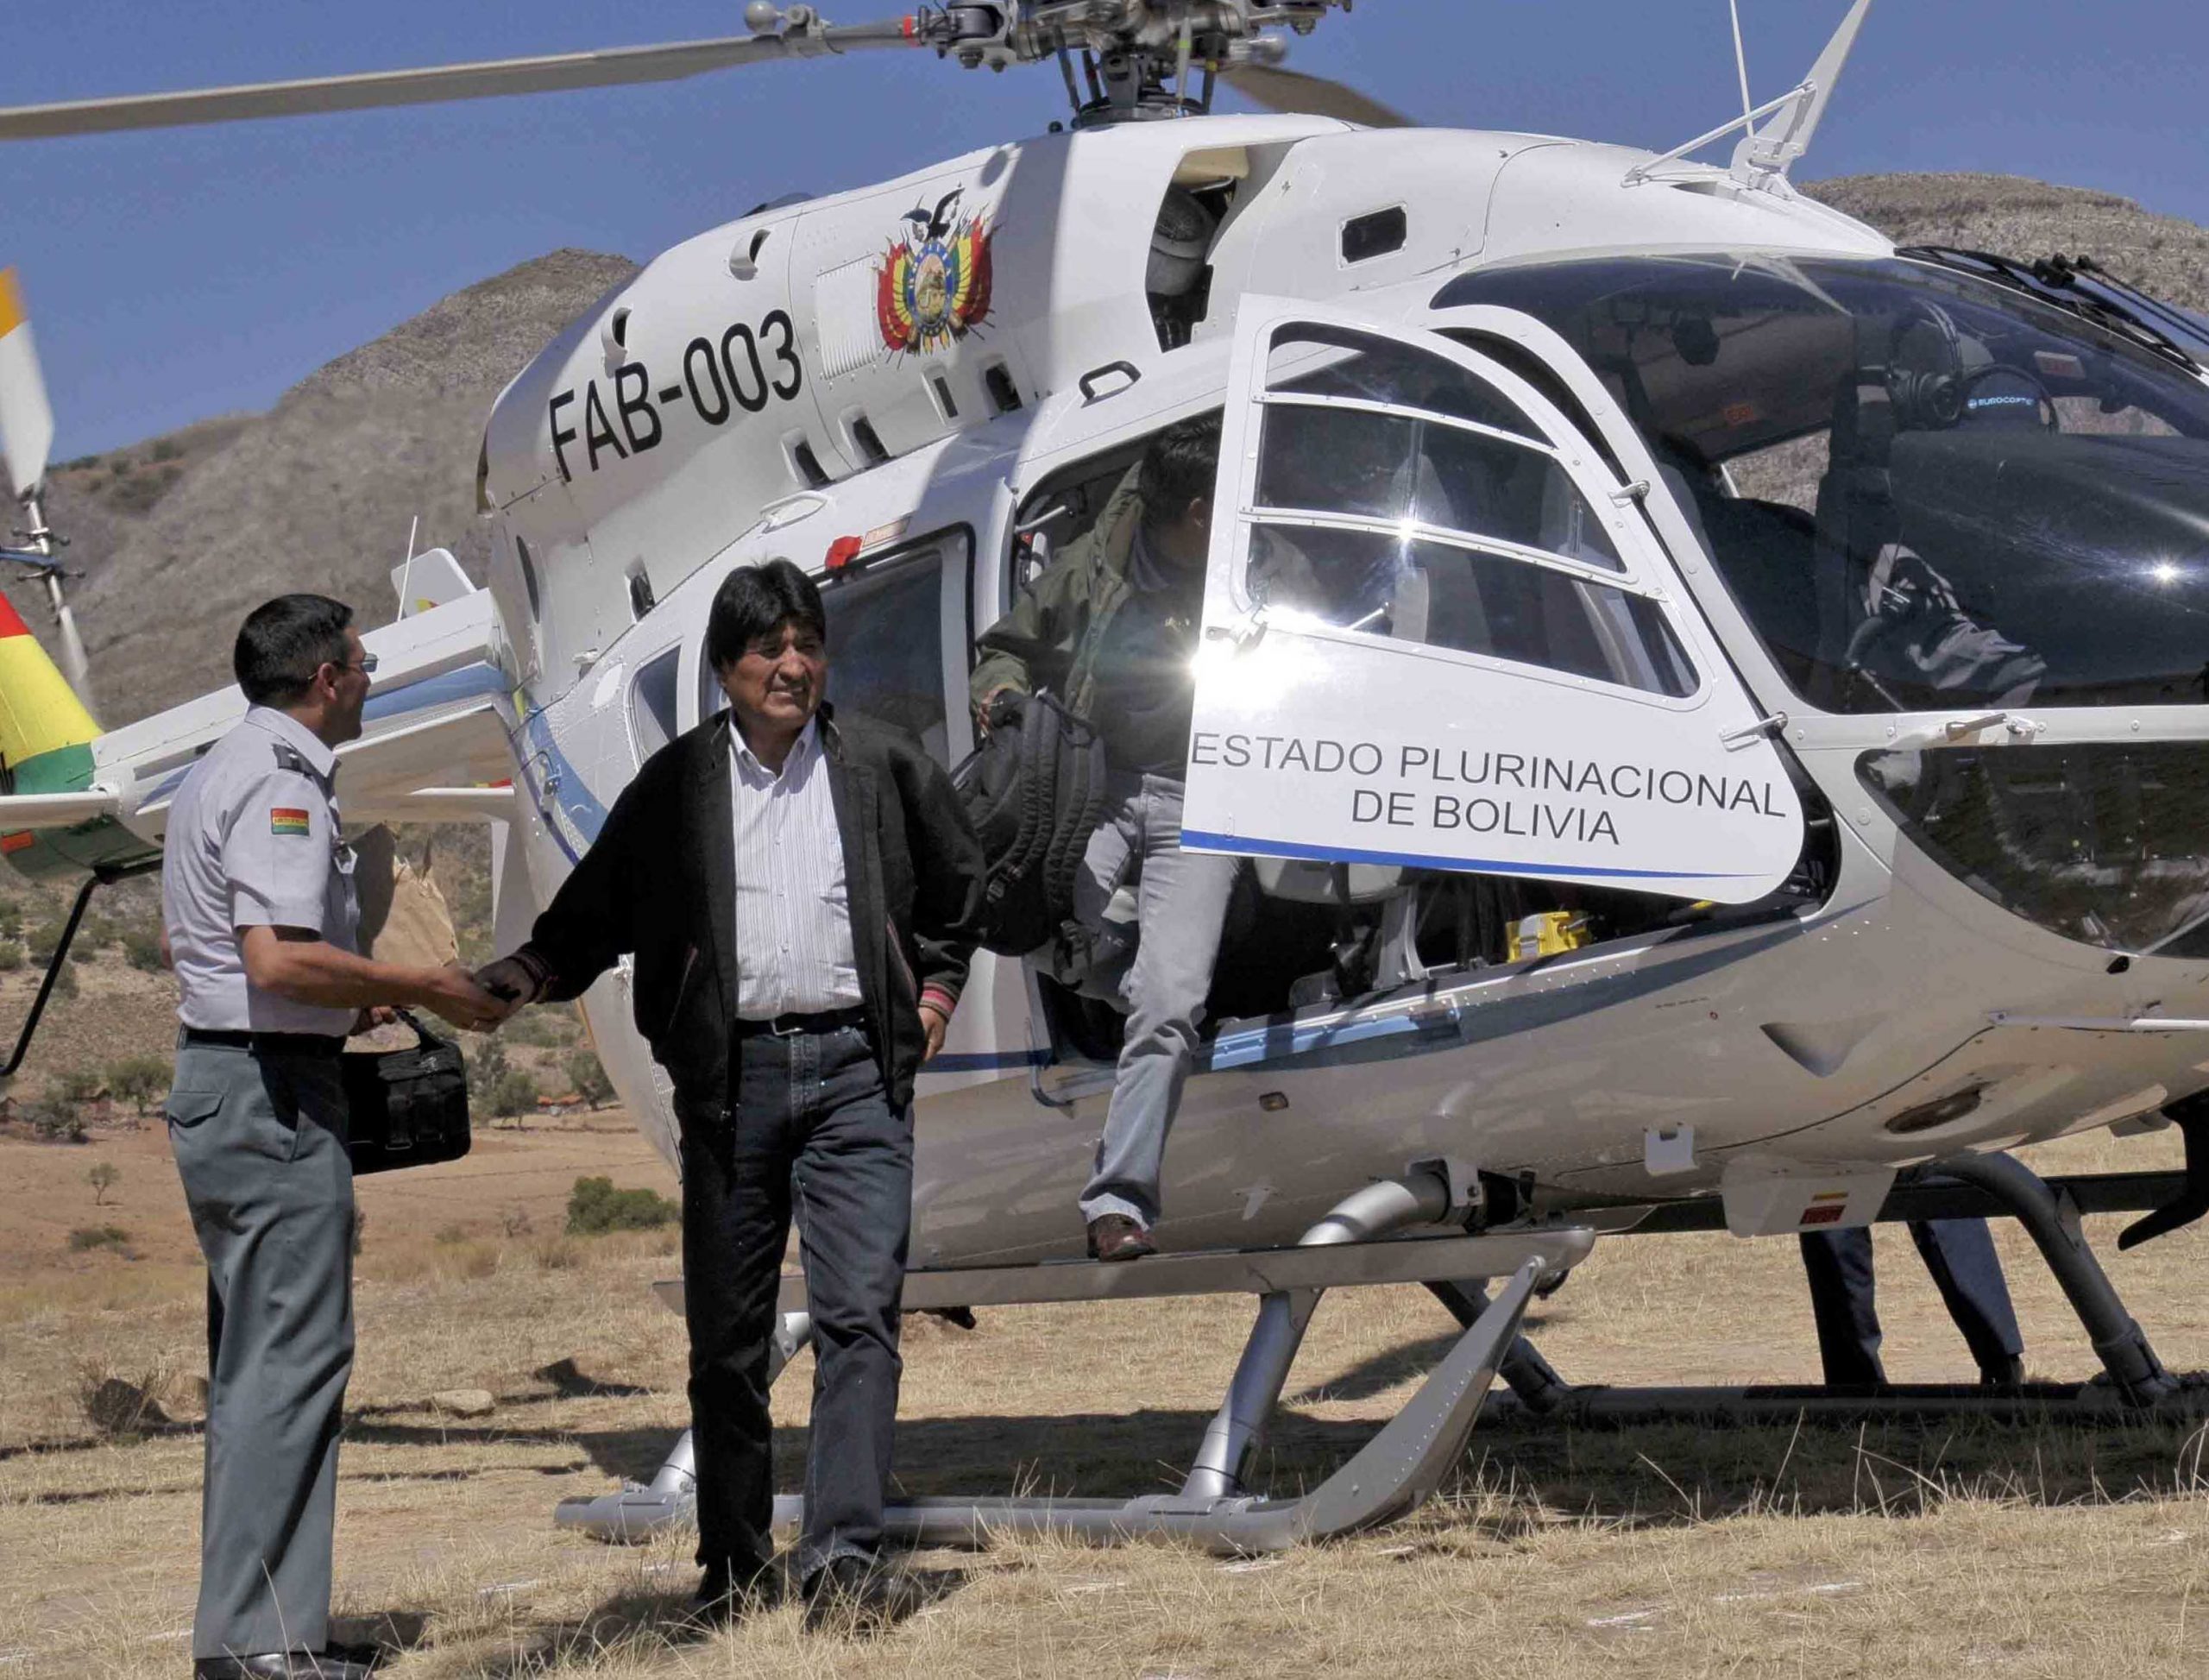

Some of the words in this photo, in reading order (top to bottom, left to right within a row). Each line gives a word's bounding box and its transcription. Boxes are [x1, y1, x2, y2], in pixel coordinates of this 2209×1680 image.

[549, 309, 802, 483] FAB-003
[1978, 396, 2035, 406] EUROCO
[1191, 732, 1382, 776] ESTADO
[1399, 746, 1787, 818] PLURINACIONAL
[1351, 789, 1416, 827] DE
[1432, 795, 1621, 846] BOLIVIA
